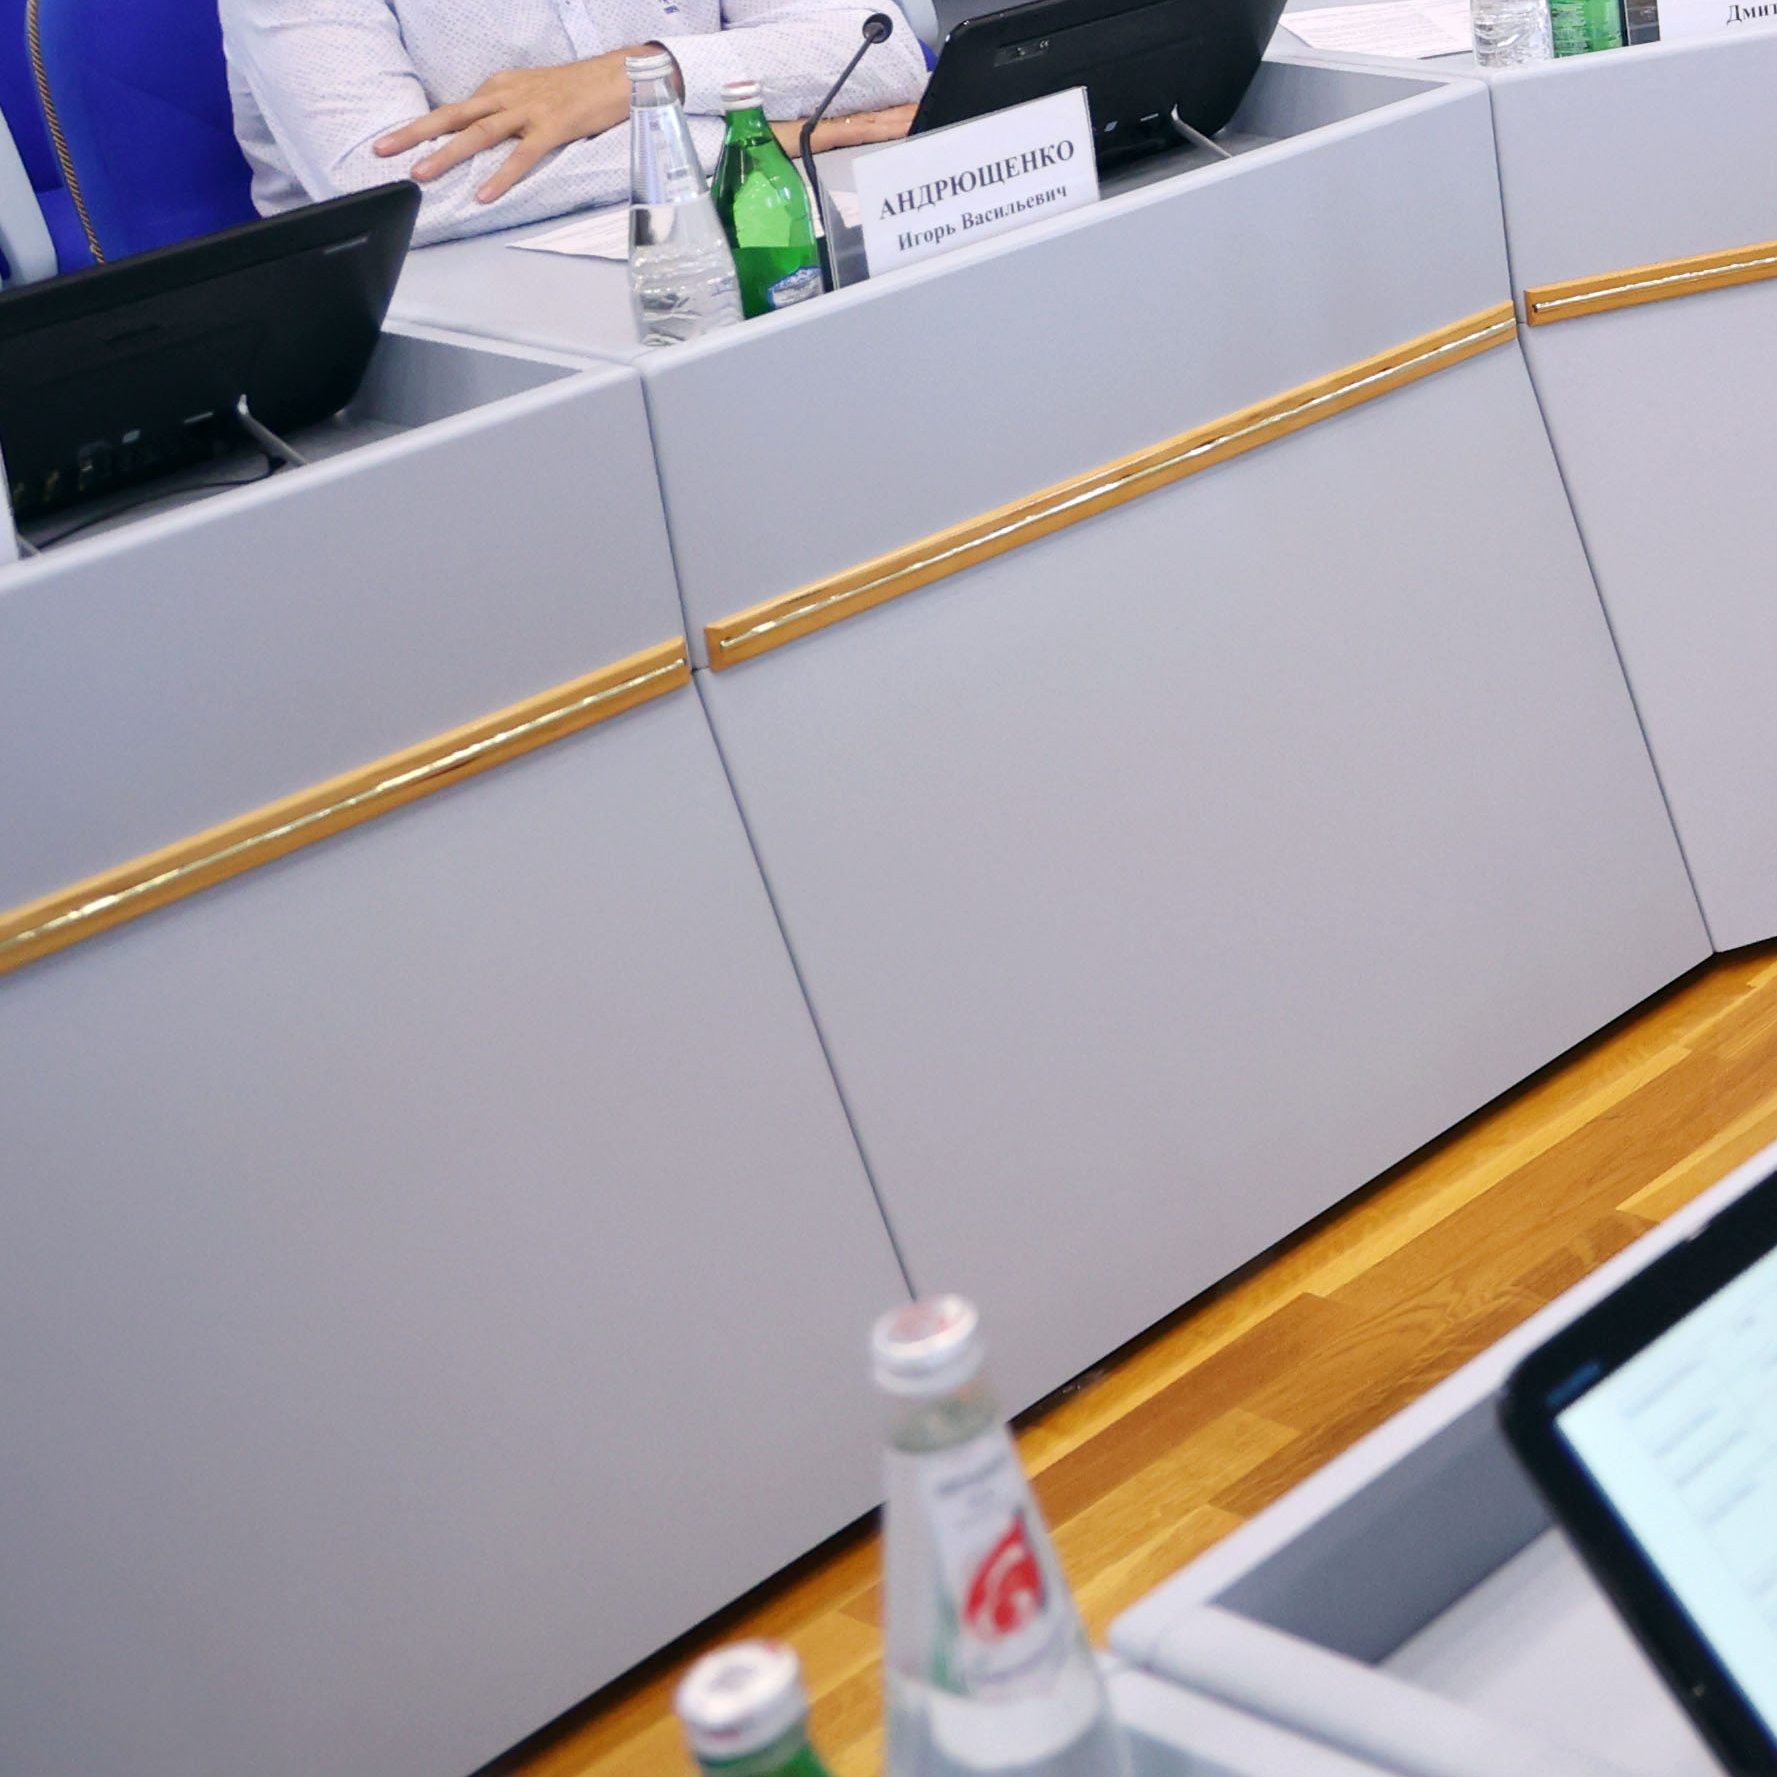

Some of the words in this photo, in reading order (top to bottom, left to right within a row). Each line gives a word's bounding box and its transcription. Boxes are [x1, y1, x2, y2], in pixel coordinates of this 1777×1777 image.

[879, 139, 1075, 220] АНДРЮЩЕНКО
[898, 223, 956, 251] Игорь
[960, 185, 1067, 231] Васильевич
